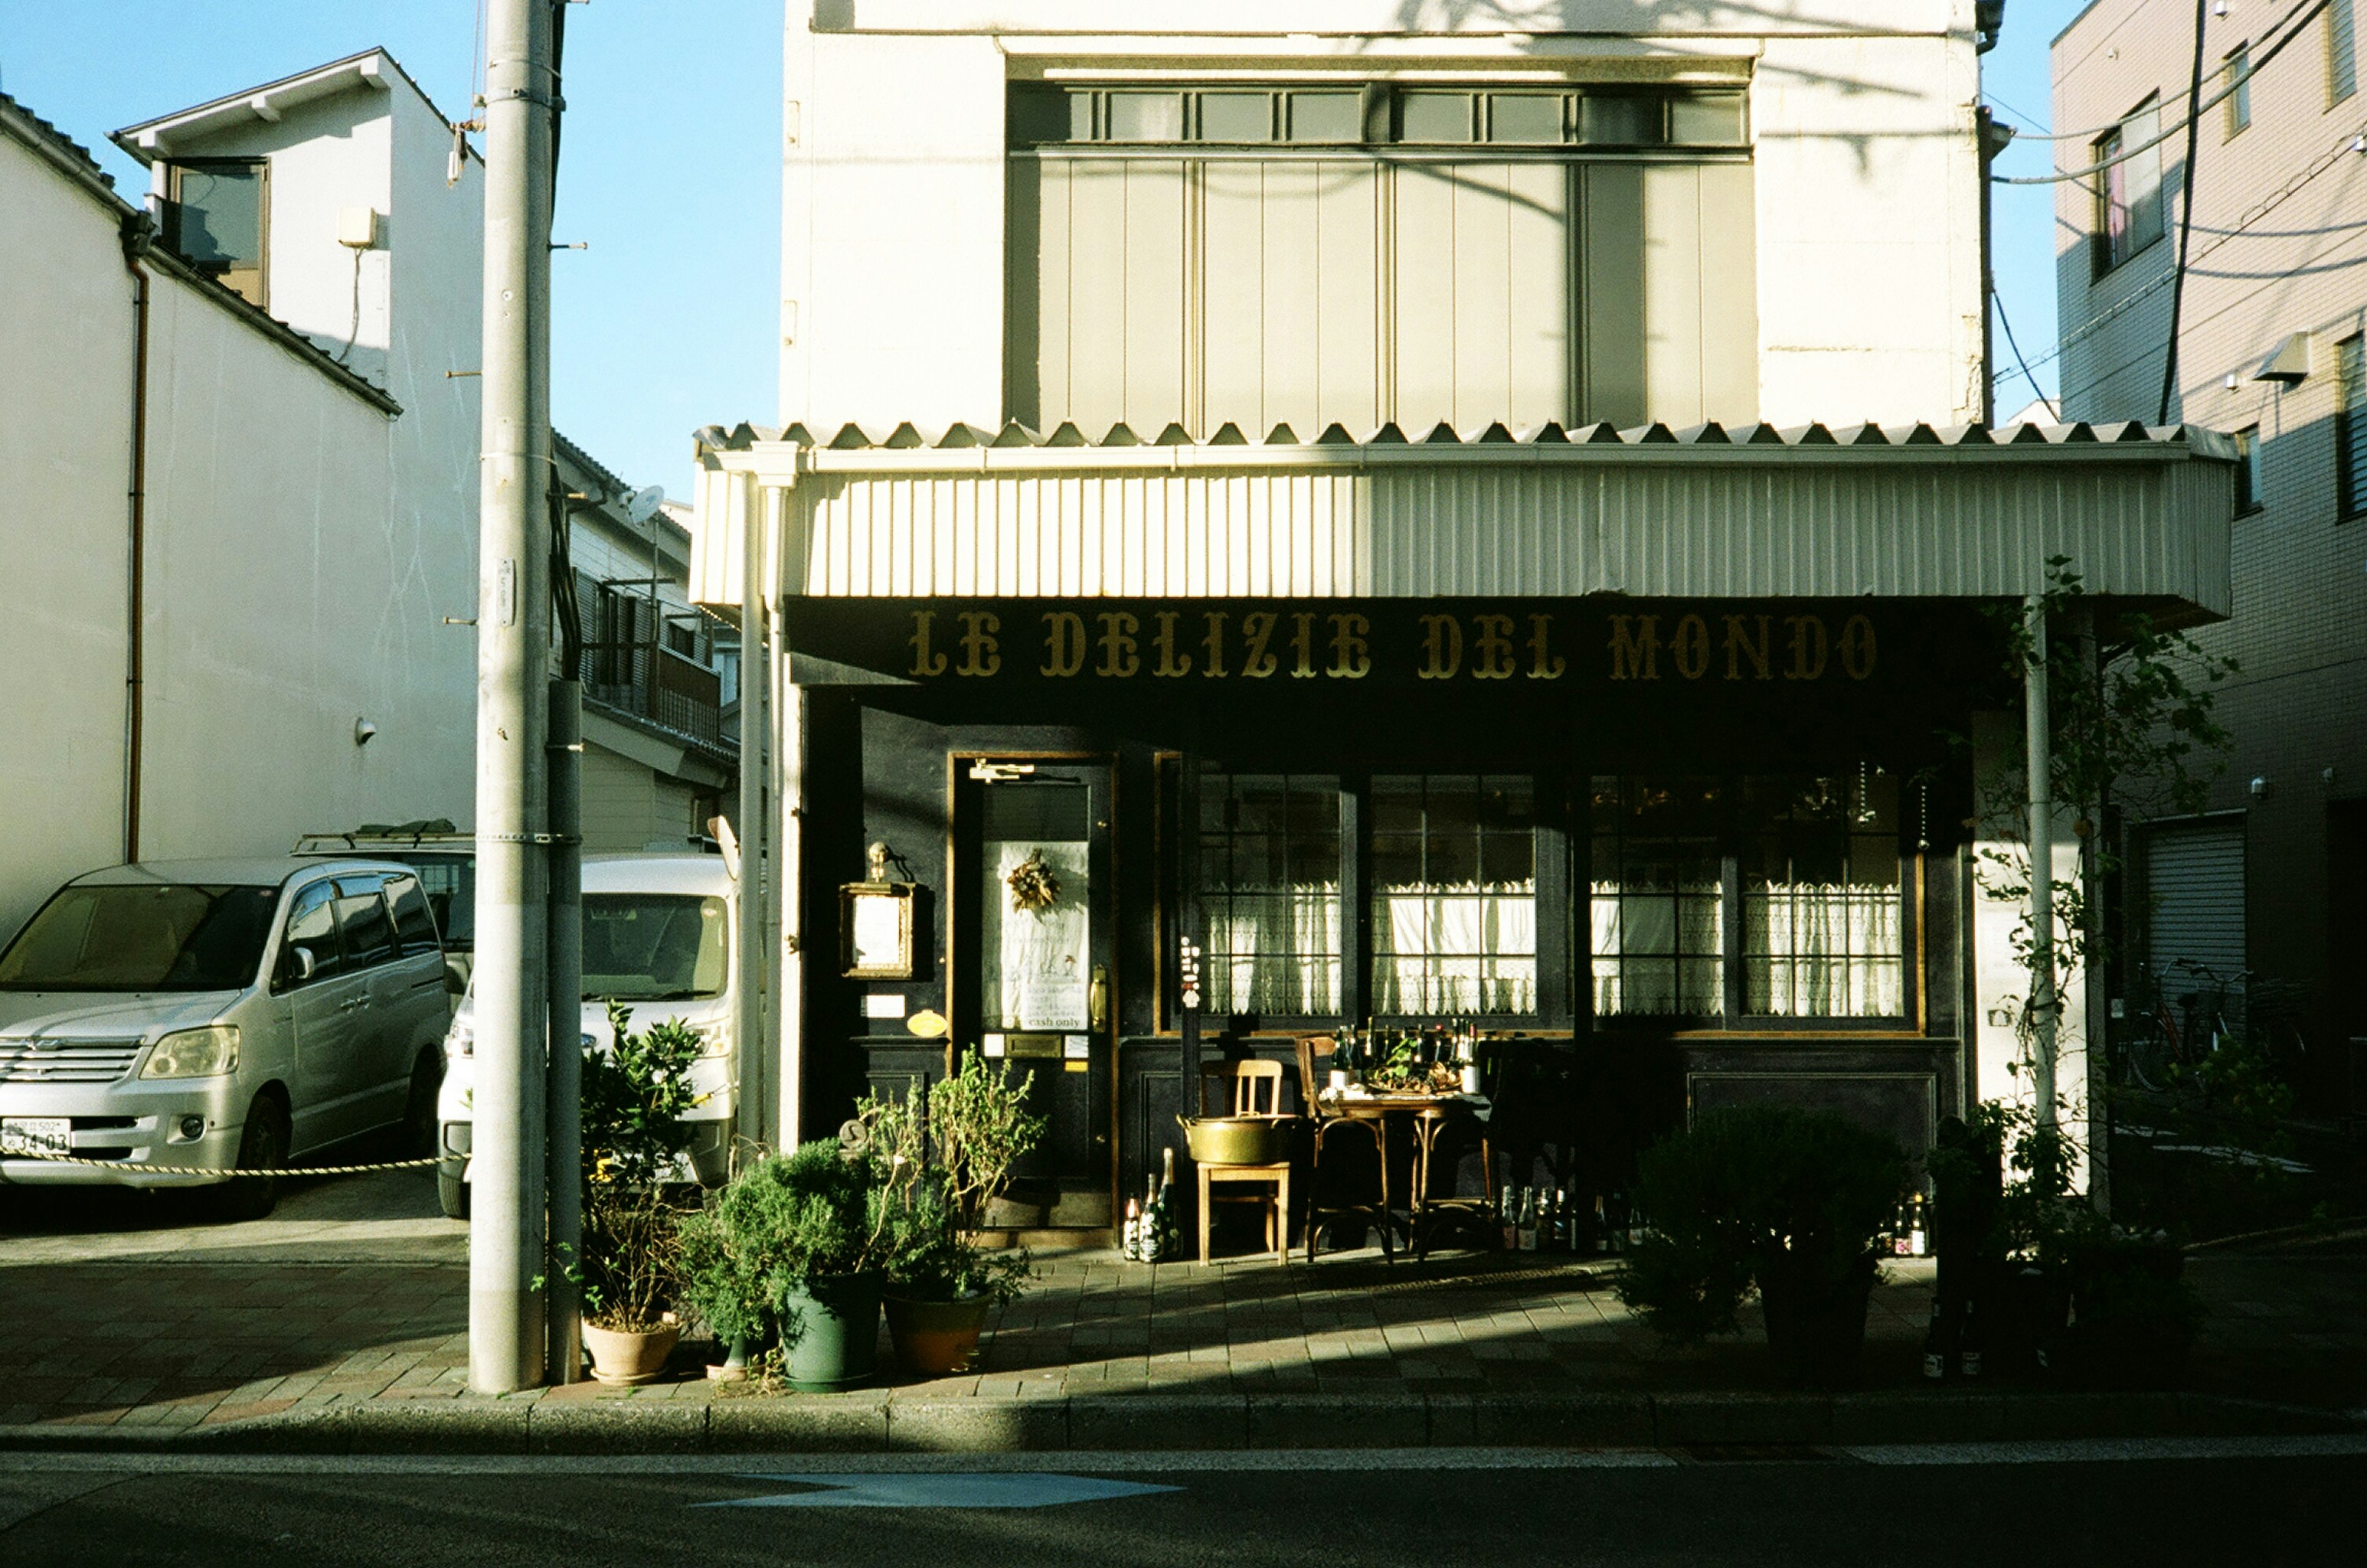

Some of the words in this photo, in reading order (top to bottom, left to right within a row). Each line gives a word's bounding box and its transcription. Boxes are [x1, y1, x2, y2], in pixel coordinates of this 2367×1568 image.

[908, 611, 1001, 678] LE
[1040, 611, 1371, 679] DELIZIE
[1417, 612, 1567, 681] DEL
[1607, 612, 1878, 681] MONDO
[1029, 1018, 1053, 1026] cash
[1056, 1018, 1079, 1027] only
